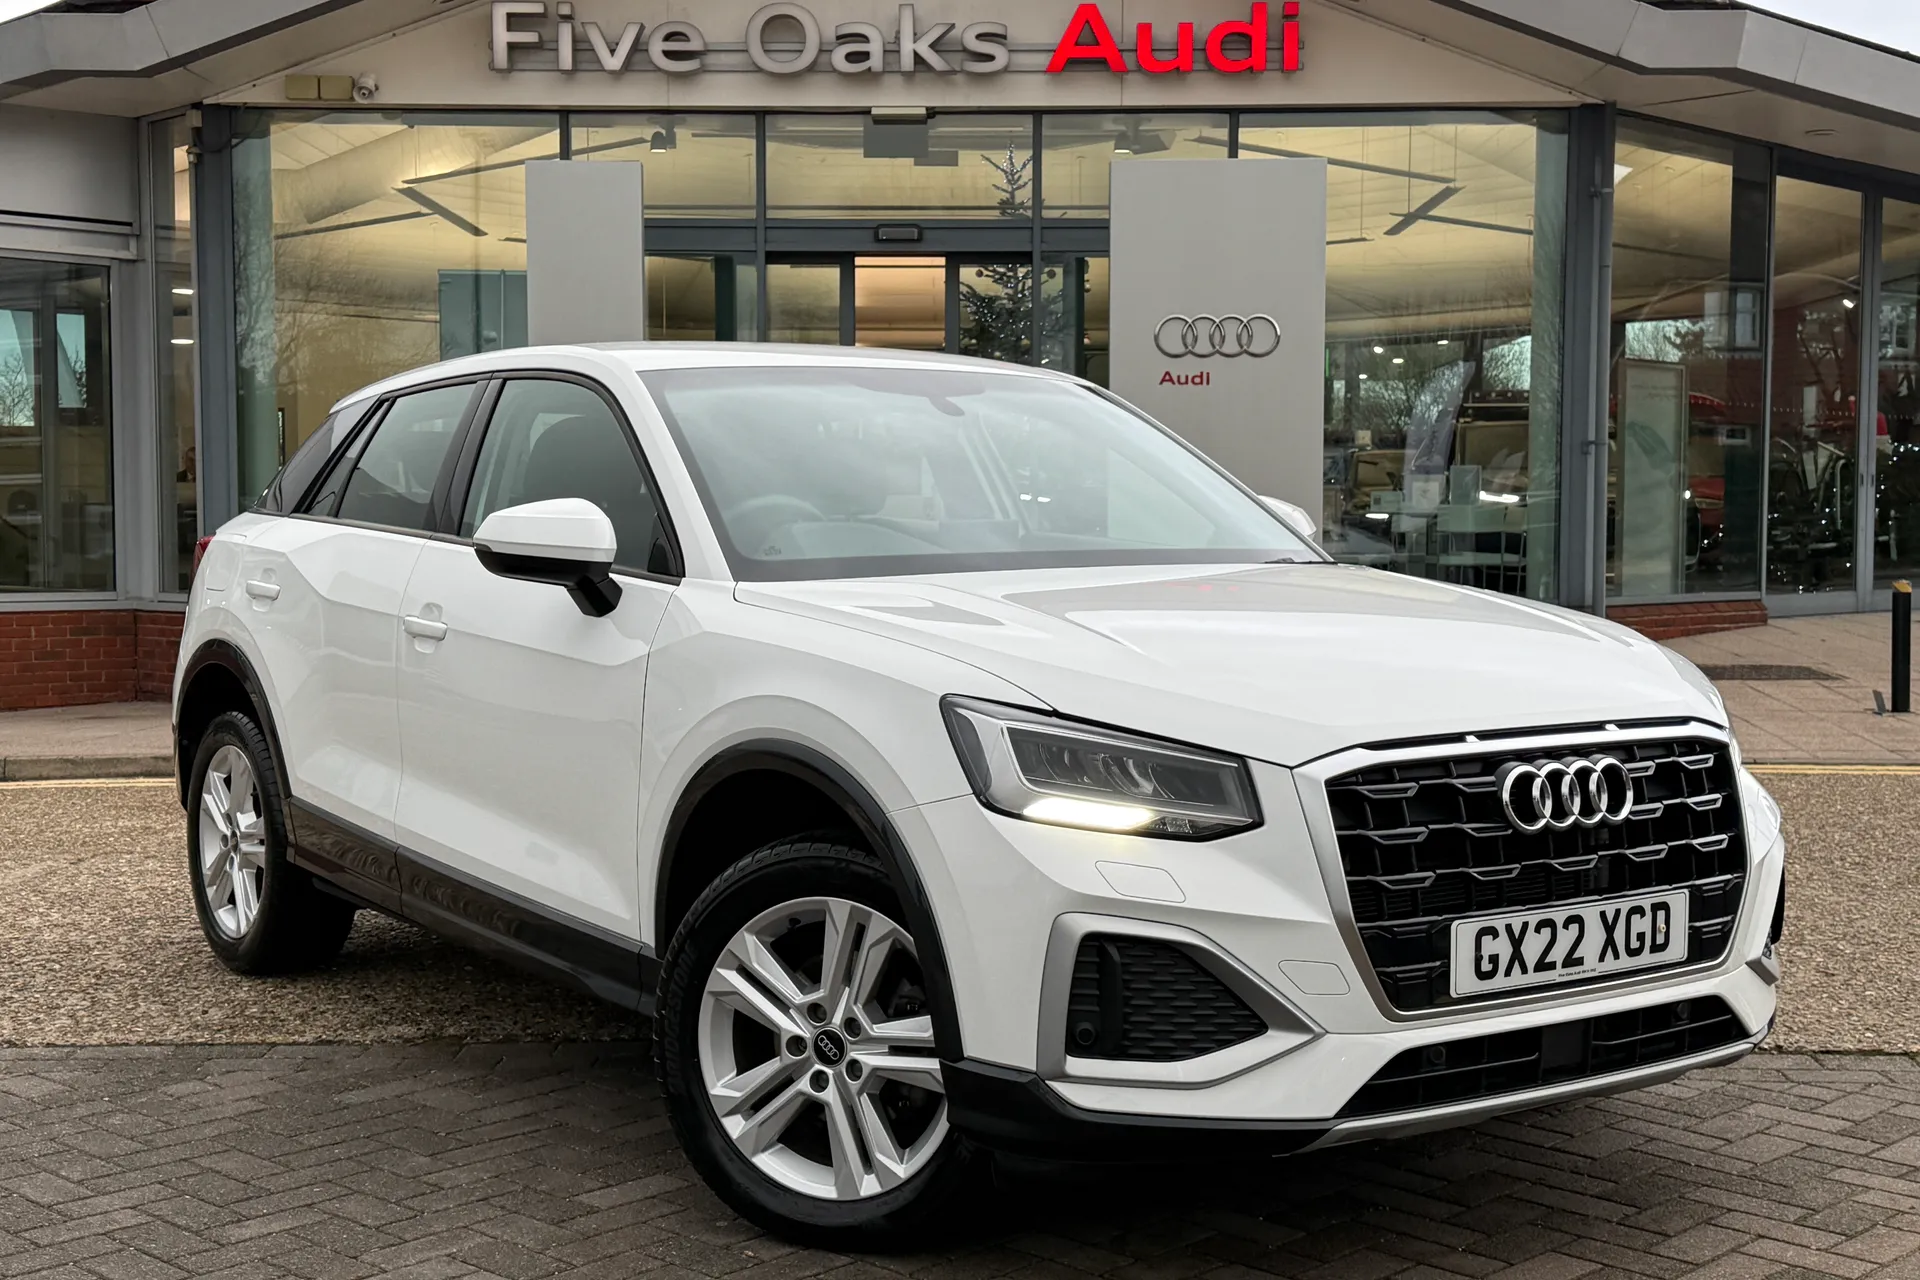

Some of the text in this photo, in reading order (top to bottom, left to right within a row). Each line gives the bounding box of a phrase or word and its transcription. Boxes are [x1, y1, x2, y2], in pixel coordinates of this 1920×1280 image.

[491, 1, 1299, 75] Five Oaks Audi
[1159, 371, 1211, 386] Audi
[1474, 901, 1671, 981] GX22 XGD
